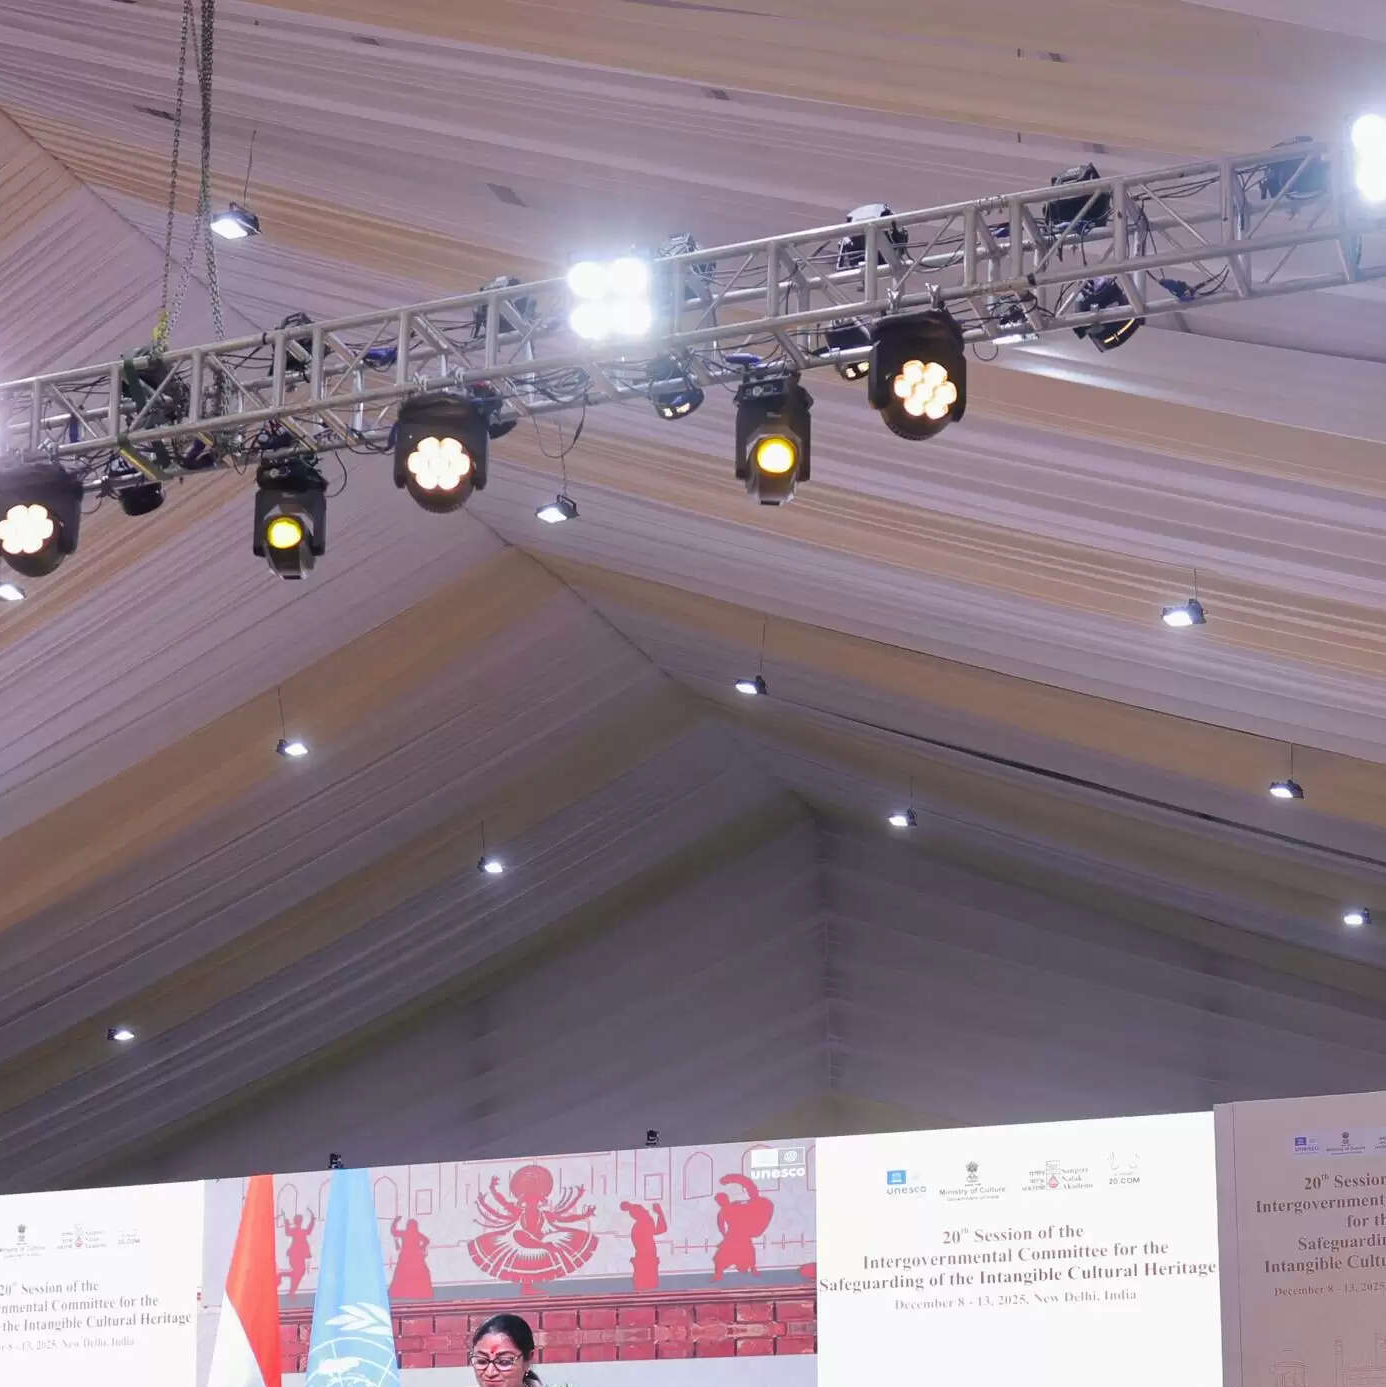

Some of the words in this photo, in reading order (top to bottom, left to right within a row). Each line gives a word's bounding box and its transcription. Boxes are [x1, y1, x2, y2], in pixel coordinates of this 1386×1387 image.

[751, 1167, 806, 1180] unesco
[1304, 1173, 1329, 1190] 20th
[886, 1185, 927, 1196] unesco
[1347, 1214, 1370, 1228] for
[943, 1227, 969, 1245] 20th
[974, 1227, 1032, 1243] Session
[1038, 1225, 1055, 1239] of
[1059, 1224, 1084, 1238] the
[863, 1248, 1012, 1270] Intergovernmental
[1018, 1244, 1108, 1262] Committee
[1114, 1243, 1138, 1256] for
[1143, 1241, 1169, 1254] the
[1264, 1256, 1343, 1275] Intangible
[819, 1275, 925, 1293] Safeguarding
[929, 1273, 945, 1287] of
[949, 1272, 974, 1285] the
[980, 1267, 1062, 1285] Intangible
[1067, 1263, 1138, 1280] Cultural
[1144, 1260, 1217, 1277] Heritage
[21, 1281, 63, 1295] Session
[66, 1280, 78, 1293] of
[81, 1279, 99, 1292] the
[1274, 1285, 1325, 1297] December
[51, 1297, 115, 1312] Committee
[119, 1296, 136, 1308] for
[140, 1294, 159, 1307] the
[895, 1297, 954, 1310] December
[957, 1296, 965, 1307] 8
[1034, 1292, 1059, 1304] New
[1104, 1288, 1137, 1301] India
[3, 1320, 20, 1332] the
[24, 1315, 83, 1331] Intangible
[86, 1313, 137, 1328] Cultural
[140, 1312, 192, 1326] Heritage
